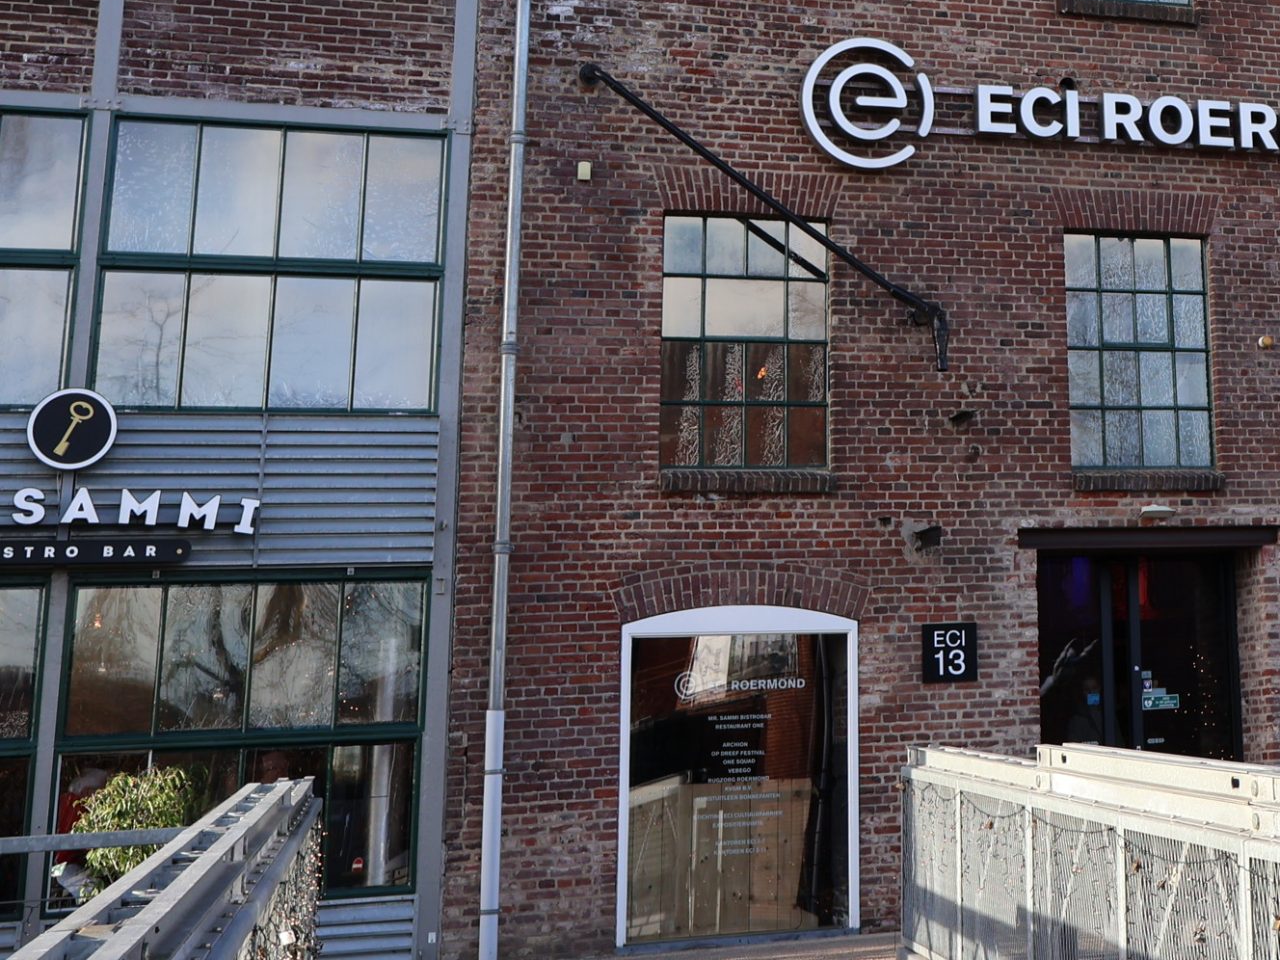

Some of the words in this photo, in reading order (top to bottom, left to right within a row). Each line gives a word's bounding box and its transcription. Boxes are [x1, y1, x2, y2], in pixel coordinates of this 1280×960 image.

[975, 84, 1080, 138] ECI
[11, 487, 261, 535] SAMMI
[102, 545, 157, 558] BAR
[934, 629, 966, 648] ECI
[934, 649, 966, 676] 13
[731, 678, 806, 691] ROERMOND
